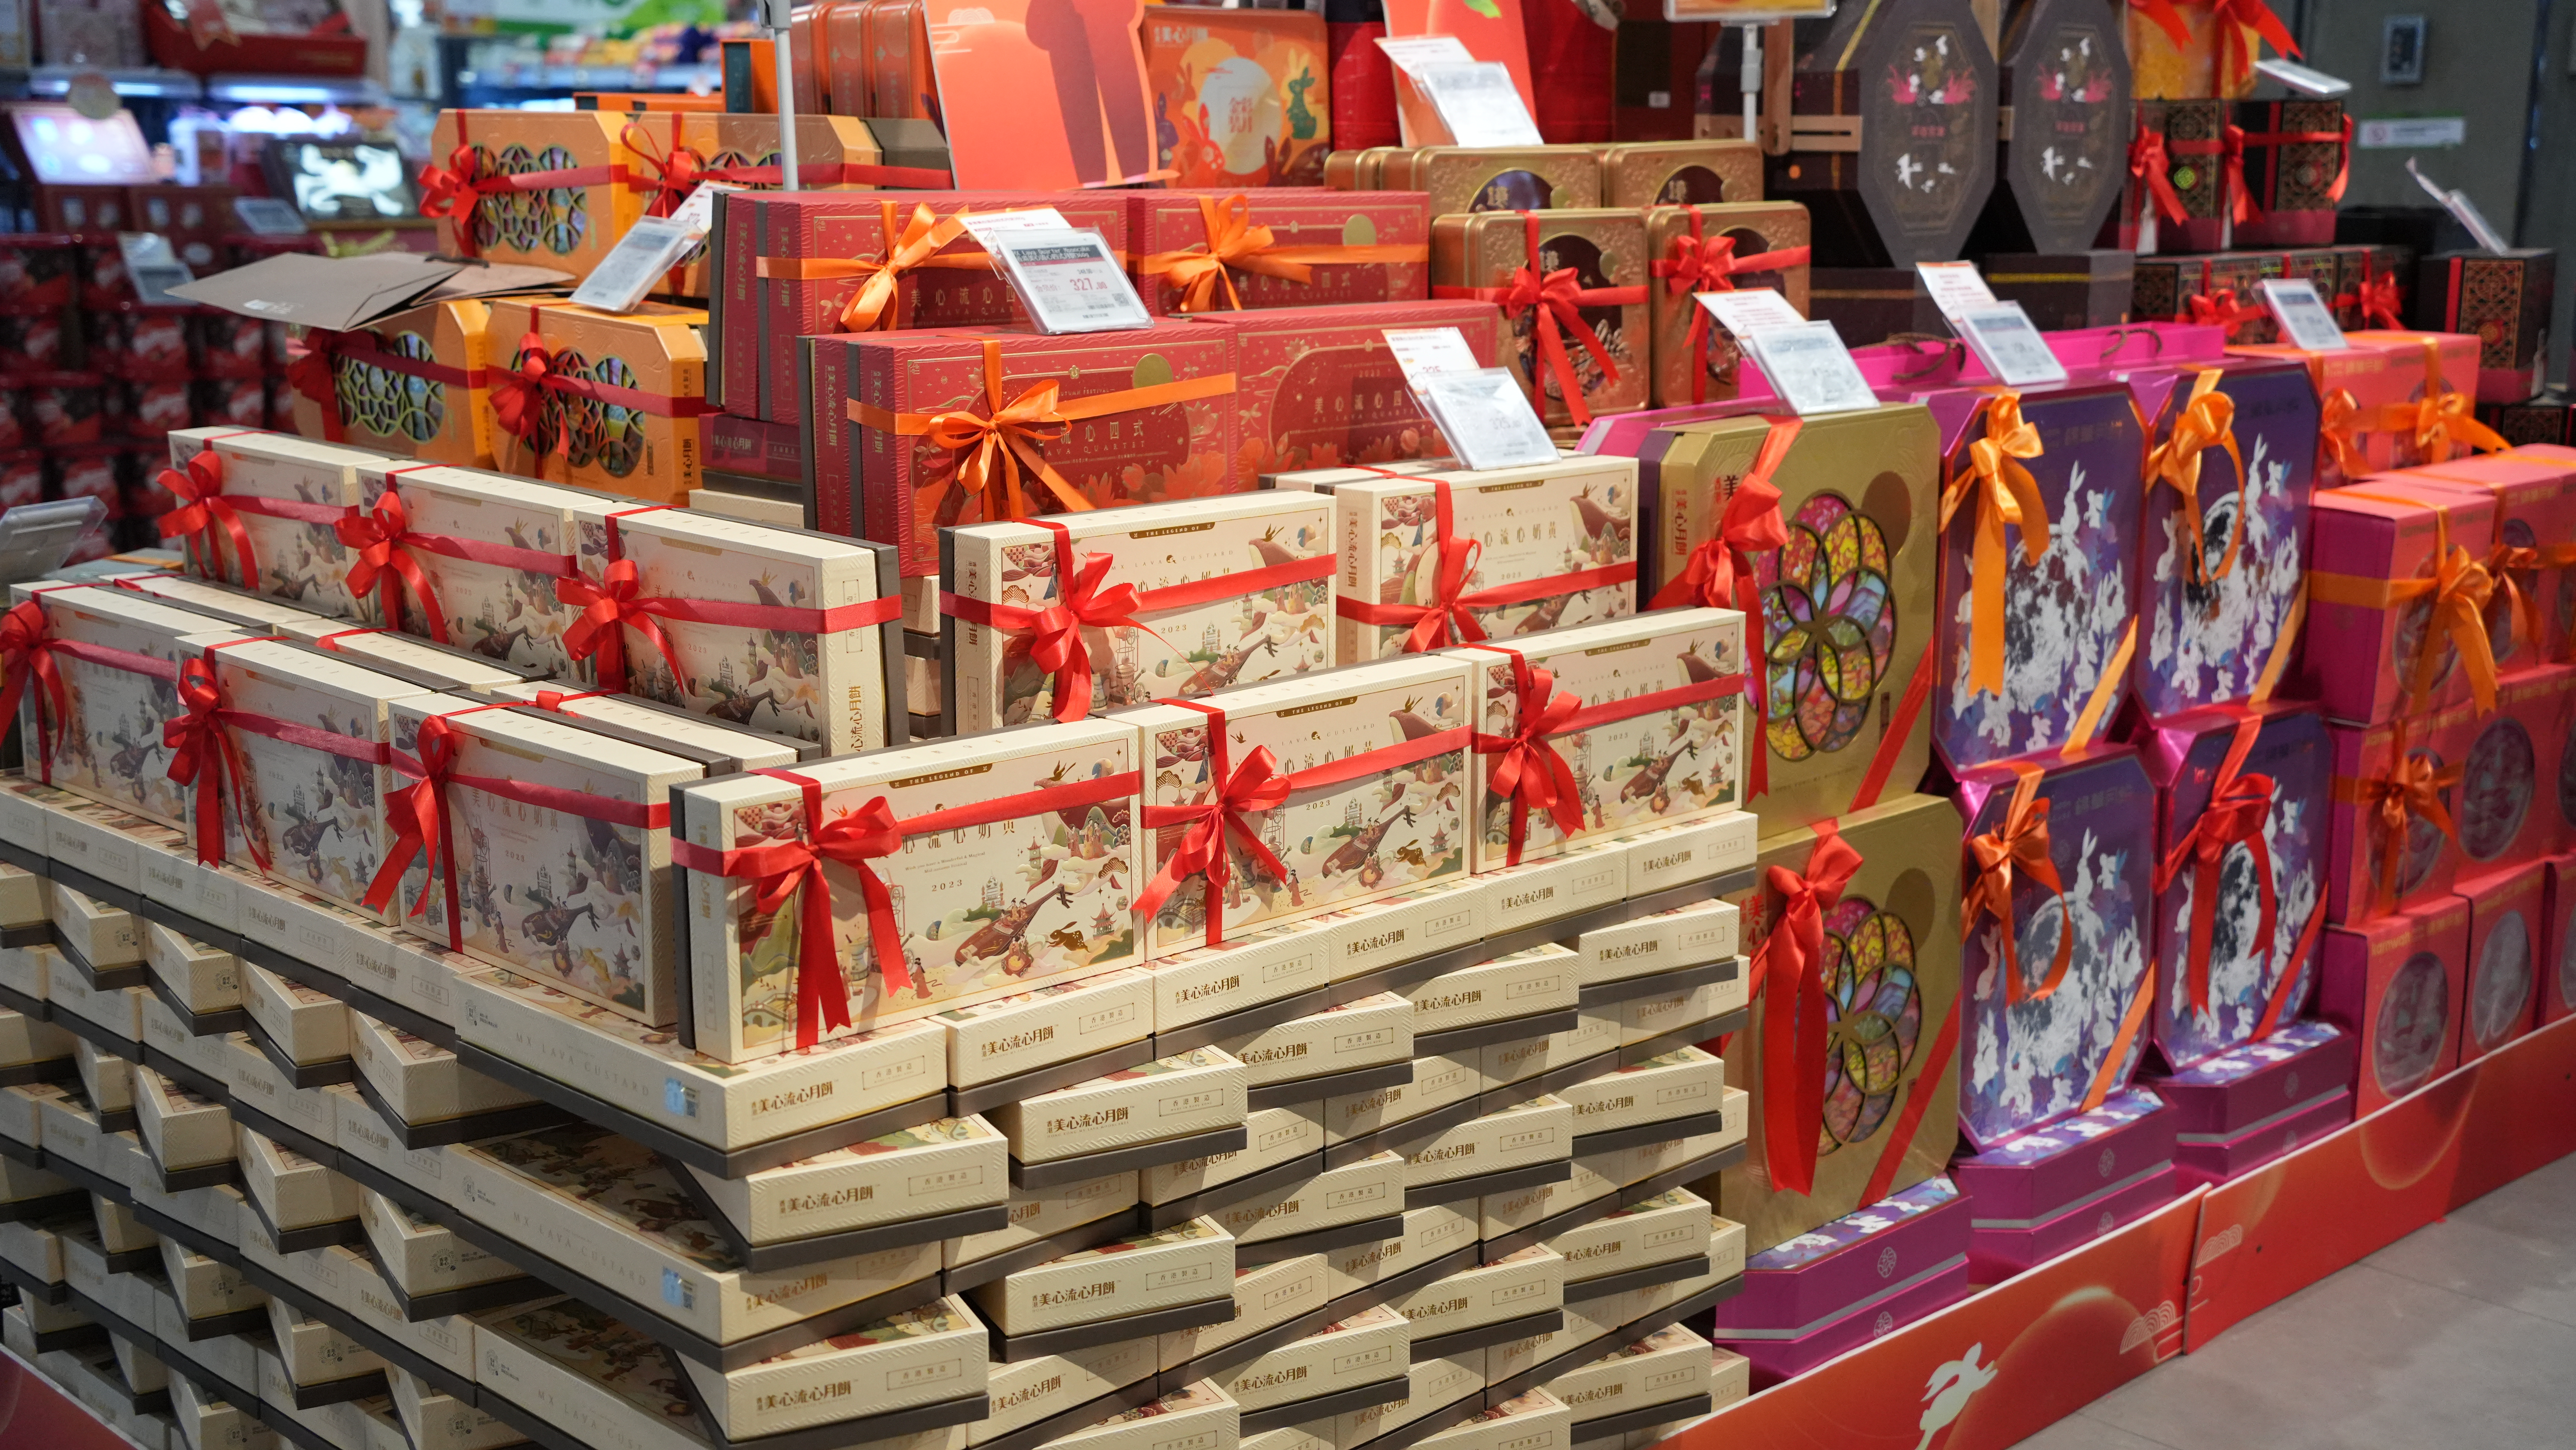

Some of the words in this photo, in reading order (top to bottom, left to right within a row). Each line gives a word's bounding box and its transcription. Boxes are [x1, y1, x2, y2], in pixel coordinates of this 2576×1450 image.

[911, 284, 1016, 308] 美心流心四
[827, 373, 837, 446] 美心流心月餅
[1314, 390, 1402, 414] 美心流心四
[1038, 447, 1071, 457] LAVA
[1083, 440, 1144, 454] QUARTET
[1135, 559, 1162, 568] LAVA
[1183, 550, 1233, 561] CUSTARD
[1348, 517, 1357, 588] 美心流心月餅
[969, 568, 977, 646] 美心月餅
[1162, 625, 1187, 633] 2023
[688, 644, 707, 654] 2023
[1308, 703, 1332, 711] LEGEND
[849, 685, 863, 751] 心流心月餅
[1282, 737, 1307, 746] LAVA
[1327, 723, 1375, 738] CUSTARD
[1609, 733, 1628, 742] 2023
[929, 772, 959, 782] LEGEND
[1306, 800, 1330, 810] 2023
[505, 850, 525, 861] 2023
[1648, 850, 1691, 871] 美心流心月餅
[932, 879, 962, 892] 2023
[1506, 887, 1553, 909] 美心流心月餅
[1435, 916, 1461, 926] 香港製造
[1347, 943, 1351, 955] 香港
[1352, 929, 1404, 954] 美心流心月餅
[1604, 940, 1657, 959] 美心流心月餅
[1274, 960, 1302, 972] 香港製造
[1176, 992, 1180, 1004] 香港
[1181, 976, 1239, 1002] 美心流心月餅
[1518, 980, 1548, 991] 香港製造
[1414, 1001, 1418, 1012] 香港
[1419, 990, 1481, 1011] 美心流心月餅
[1092, 1010, 1123, 1023] 香港製造
[987, 1026, 1053, 1056] 美心流心月餅
[1348, 1033, 1381, 1043] 香港製造
[1239, 1043, 1307, 1064] 美心流心月餅
[542, 1042, 575, 1064] LAVA
[584, 1062, 649, 1097] CUSTARD
[1431, 1072, 1457, 1084] 香港製造
[759, 1081, 833, 1112] 美心流心月餅
[1173, 1094, 1210, 1106] 香港製造
[1350, 1089, 1401, 1111] 美心流心月餅
[1577, 1096, 1633, 1115] 美心流心月餅
[1047, 1121, 1052, 1133] 香港
[1054, 1107, 1128, 1131] 美心流心月餅
[1101, 1121, 1128, 1130] MOONCAKES
[1270, 1126, 1297, 1140] 香港製造
[1512, 1132, 1542, 1143] 香港製造
[1413, 1143, 1475, 1165] 美心流心月餅
[790, 1186, 873, 1212] 美心流心月餅
[1339, 1188, 1372, 1199] 香港製造
[1009, 1202, 1040, 1223] 心月餅
[1231, 1200, 1299, 1224] 美心流心月餅
[1431, 1224, 1455, 1236] 香港製造
[539, 1225, 572, 1249] LAVA
[581, 1246, 647, 1286] CUSTARD
[1350, 1242, 1401, 1269] 美心流心月餅
[1564, 1241, 1621, 1261] 美心流心月餅
[1161, 1268, 1198, 1281] 香港製造
[1040, 1281, 1115, 1306] 美心流心月餅
[1275, 1284, 1302, 1299] 香港製造
[1504, 1285, 1534, 1296] 香港製造
[1406, 1297, 1467, 1320] 美心流心月餅
[1346, 1352, 1379, 1364] 香港製造
[1234, 1381, 1239, 1393] 香港
[1241, 1366, 1307, 1390] 美心流心月餅
[766, 1381, 851, 1409] 美心流心月餅
[998, 1375, 1060, 1410] 美心流心月餅
[1567, 1384, 1622, 1405] 美心流心月餅
[1511, 1437, 1541, 1449] 香港製造
